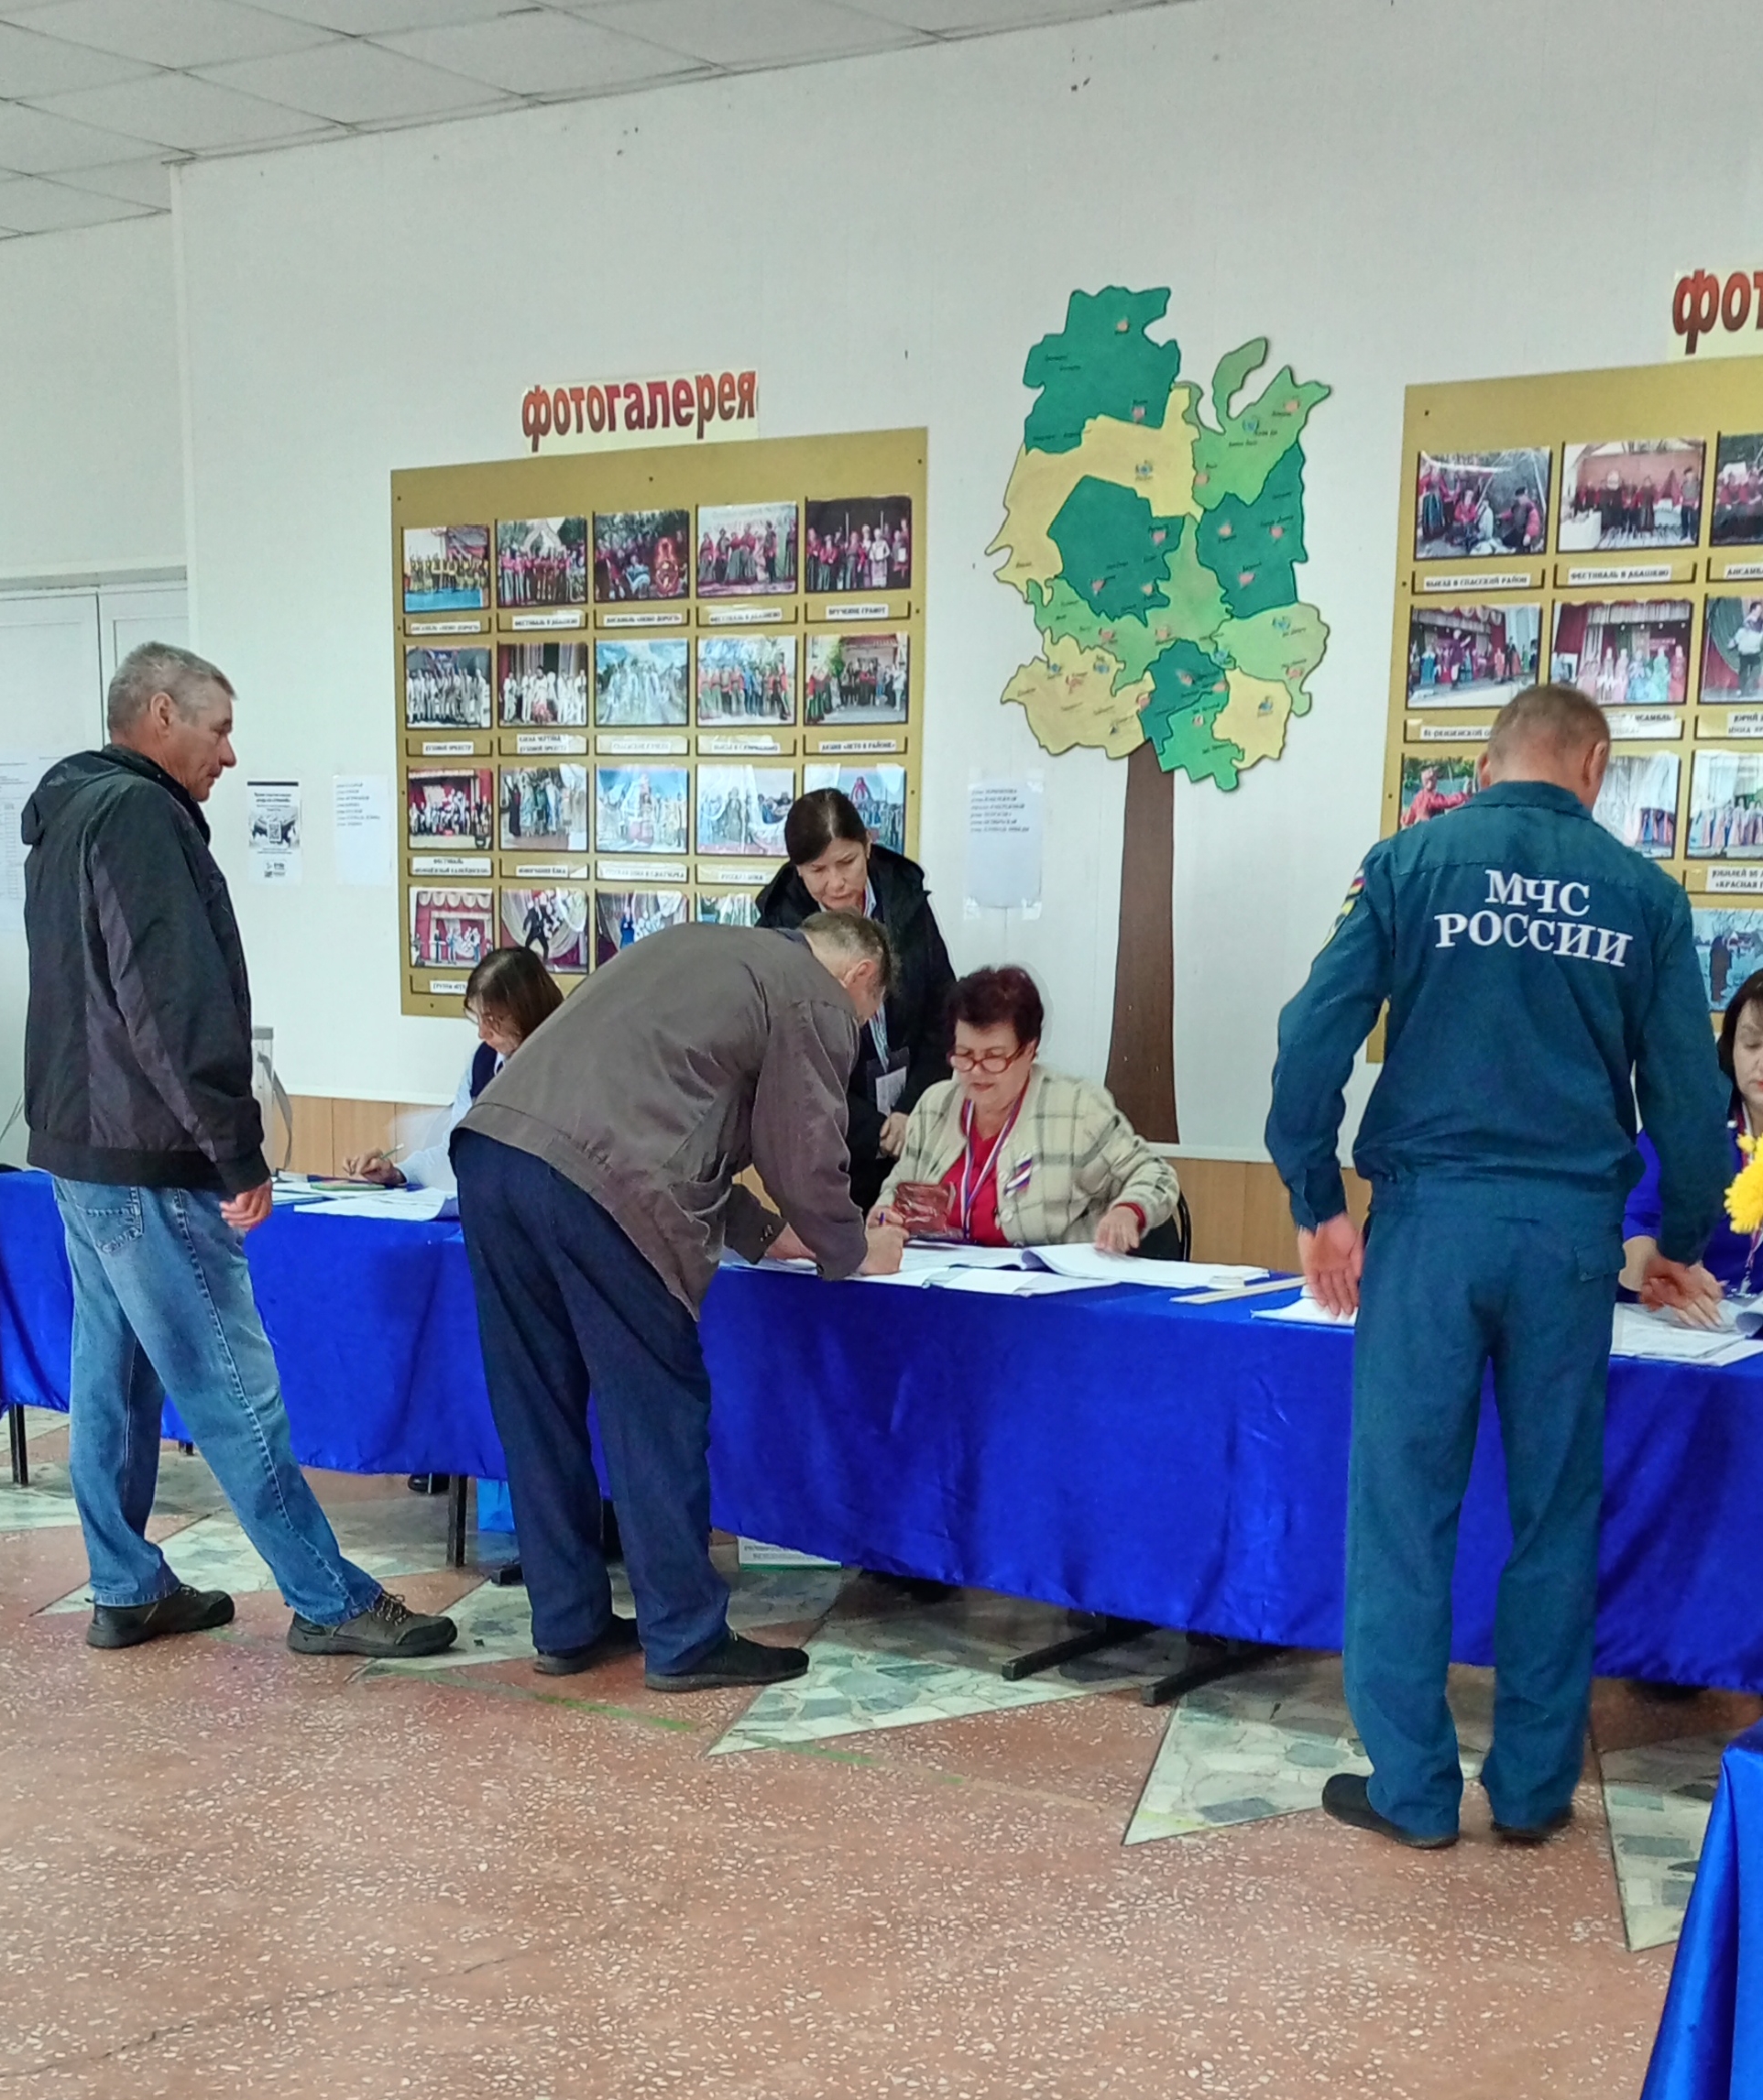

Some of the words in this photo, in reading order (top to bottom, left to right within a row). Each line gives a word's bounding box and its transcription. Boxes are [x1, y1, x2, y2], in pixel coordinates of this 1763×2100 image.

[521, 370, 757, 453] фотогалерея
[1484, 870, 1591, 917] МЧС
[1433, 910, 1634, 968] РОССИИ
